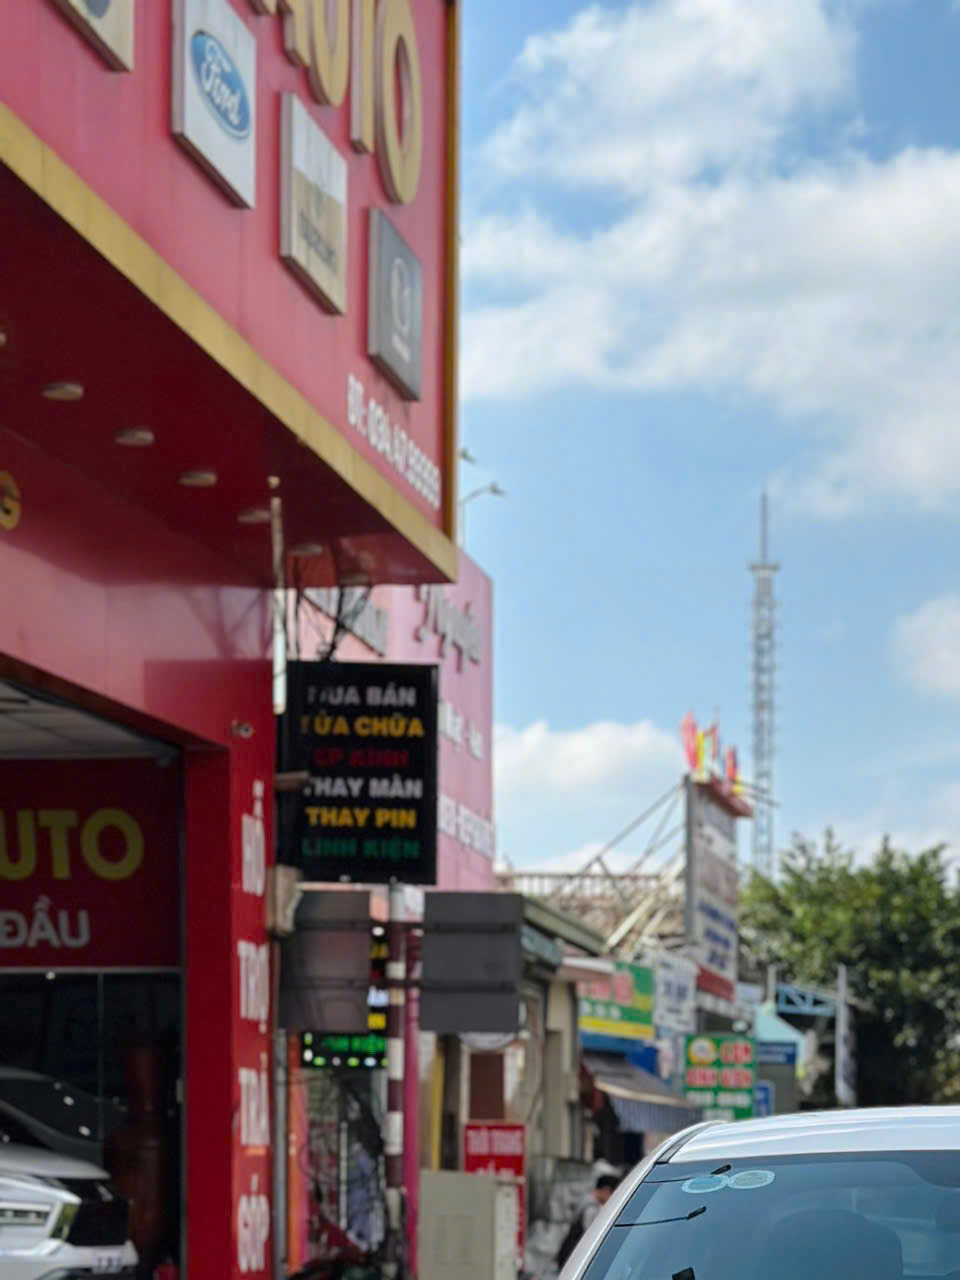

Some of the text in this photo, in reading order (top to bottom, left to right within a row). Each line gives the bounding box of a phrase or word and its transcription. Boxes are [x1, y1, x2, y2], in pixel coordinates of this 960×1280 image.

[366, 682, 417, 707] BÁN
[304, 806, 417, 829] THAY PIN
